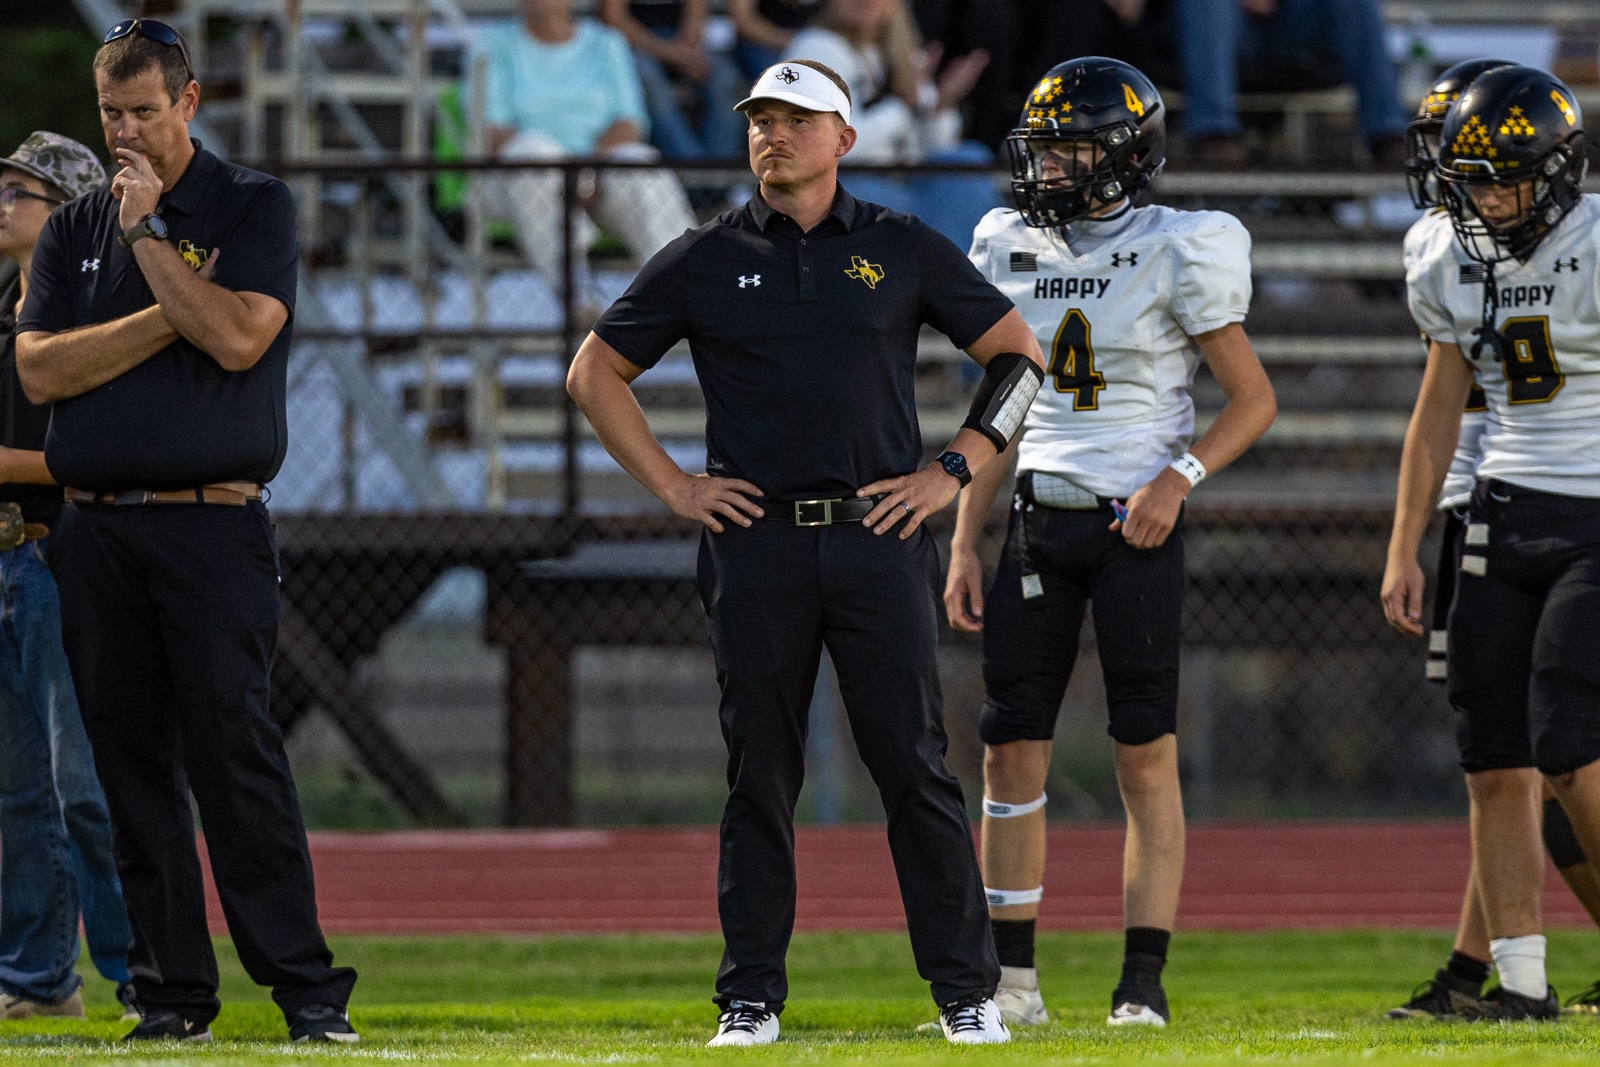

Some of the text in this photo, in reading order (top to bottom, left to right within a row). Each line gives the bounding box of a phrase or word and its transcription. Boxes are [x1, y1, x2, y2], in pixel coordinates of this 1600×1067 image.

[1121, 82, 1144, 117] 4
[1034, 277, 1111, 299] HAPPY
[1496, 285, 1555, 308] APPY
[1047, 308, 1106, 411] 4
